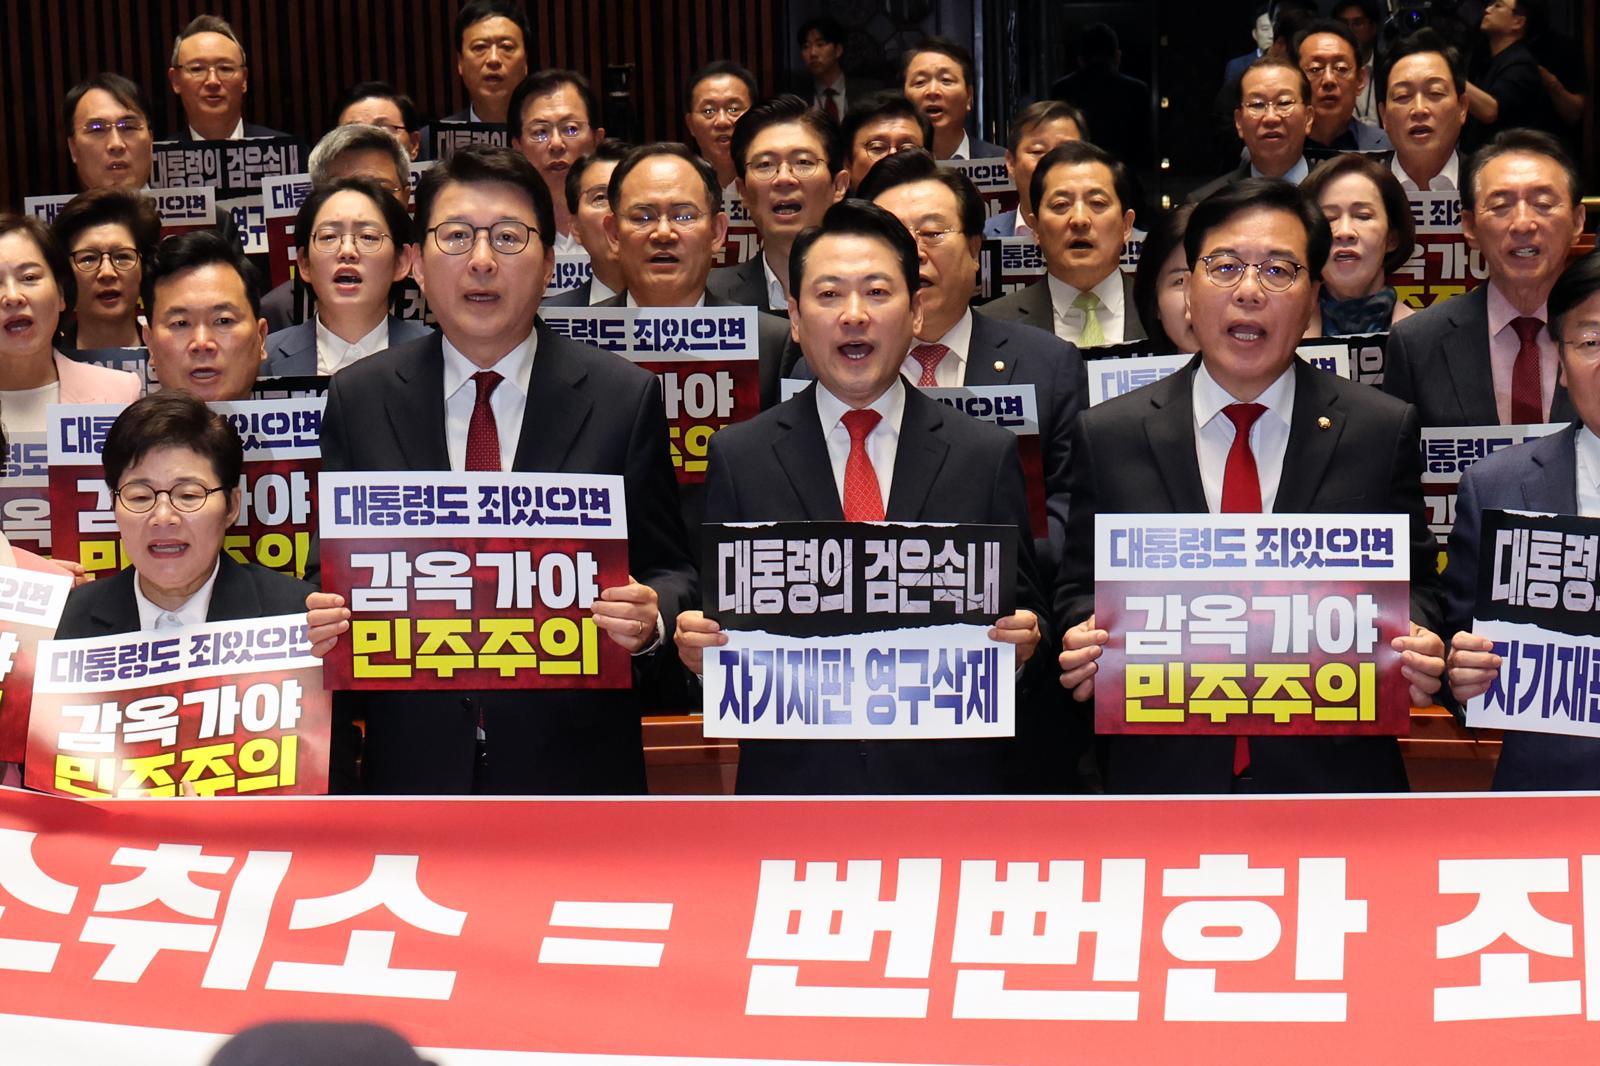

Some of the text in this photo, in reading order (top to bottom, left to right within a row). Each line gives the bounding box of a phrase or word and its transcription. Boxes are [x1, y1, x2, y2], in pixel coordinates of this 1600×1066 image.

[958, 164, 1009, 187] 으면
[156, 195, 207, 220] 으면
[633, 317, 746, 352] 죄있으면
[937, 395, 1025, 427] 으면
[334, 485, 612, 527] 대통령도 죄있으면
[718, 538, 1000, 615] 대통령의 검은속내
[1110, 527, 1248, 569] 대통령도
[1255, 527, 1395, 569] 죄있으면
[1492, 528, 1600, 613] 대통령
[50, 637, 181, 684] 대통령도
[352, 617, 599, 678] 민주주의
[719, 647, 999, 725] 자기재판 영구삭제
[1125, 662, 1376, 723] 민주주의
[1483, 639, 1600, 723] 자기재
[55, 734, 298, 799] 민주주의
[745, 854, 1367, 1022] 뻔뻔한
